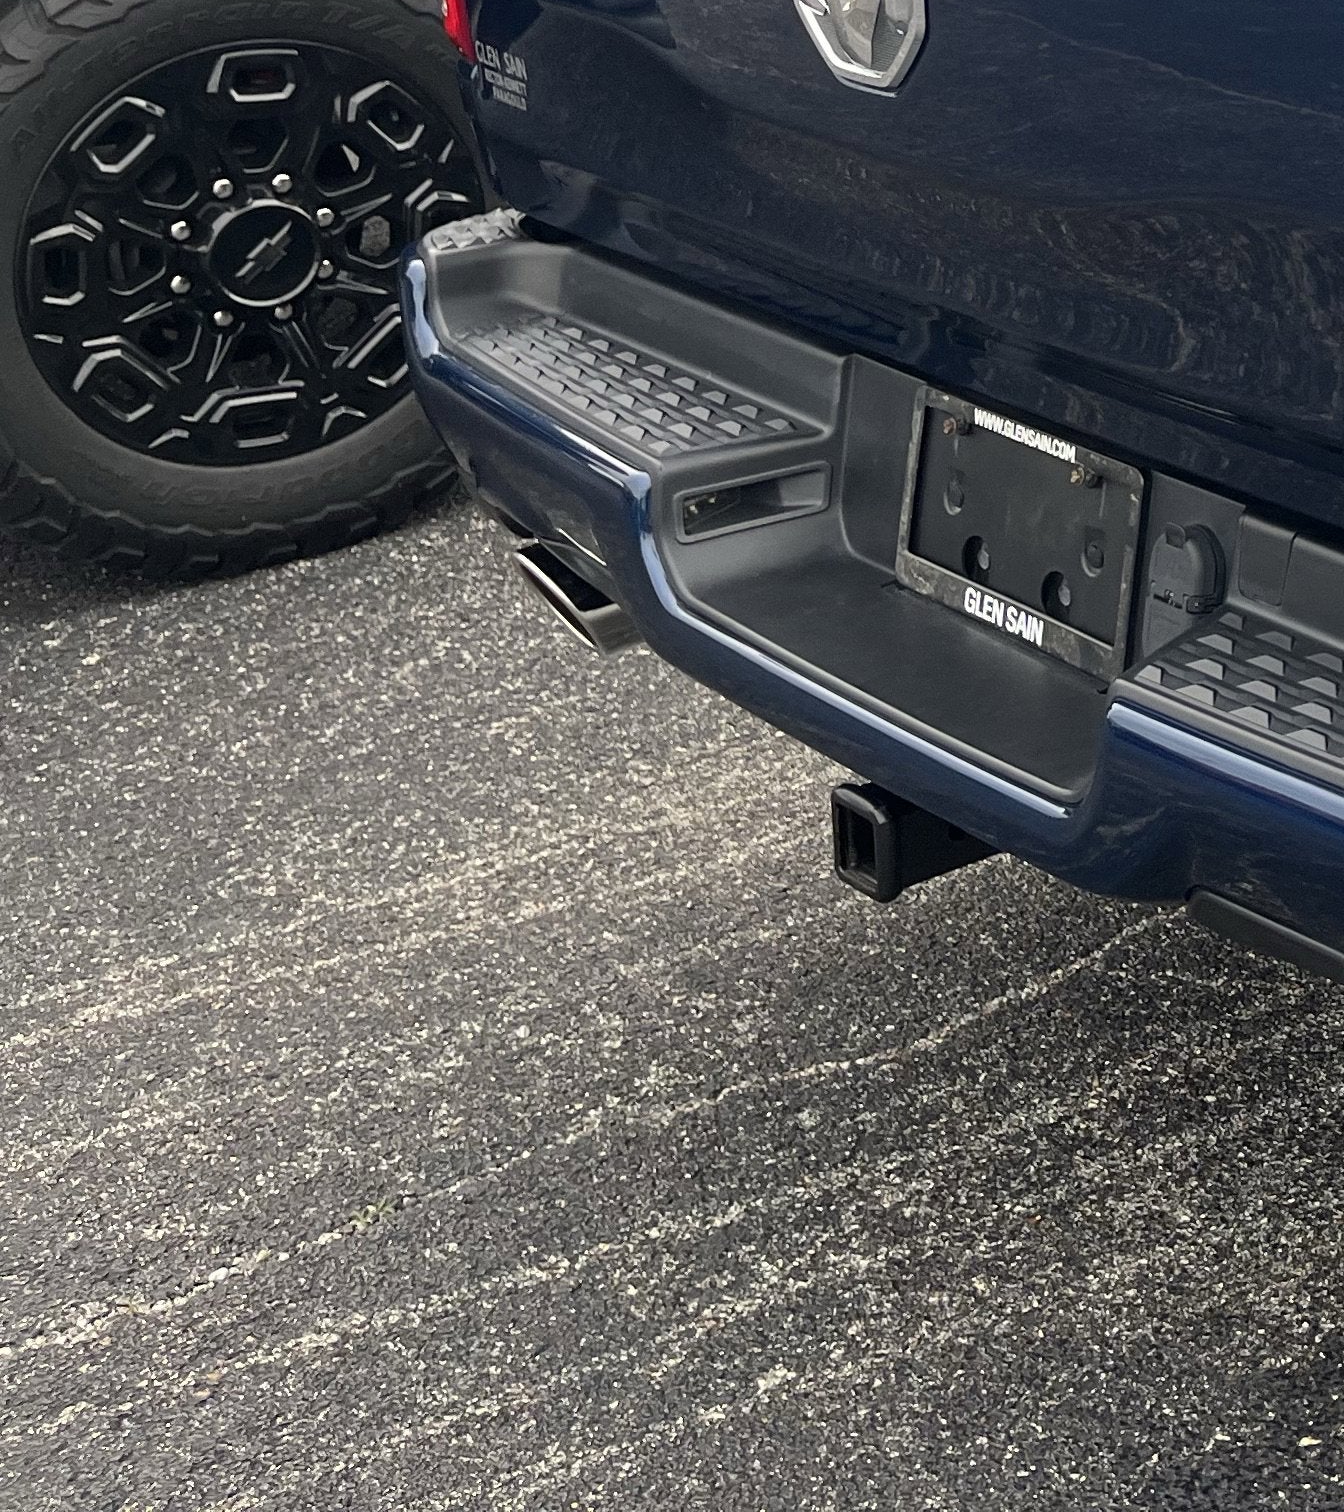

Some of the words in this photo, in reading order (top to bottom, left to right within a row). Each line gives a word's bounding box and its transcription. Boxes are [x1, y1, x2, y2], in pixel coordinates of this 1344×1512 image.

[973, 407, 1076, 463] WWW.GLENSAIN.COM
[963, 586, 1005, 628] GLEN
[1005, 607, 1045, 647] SAIN
